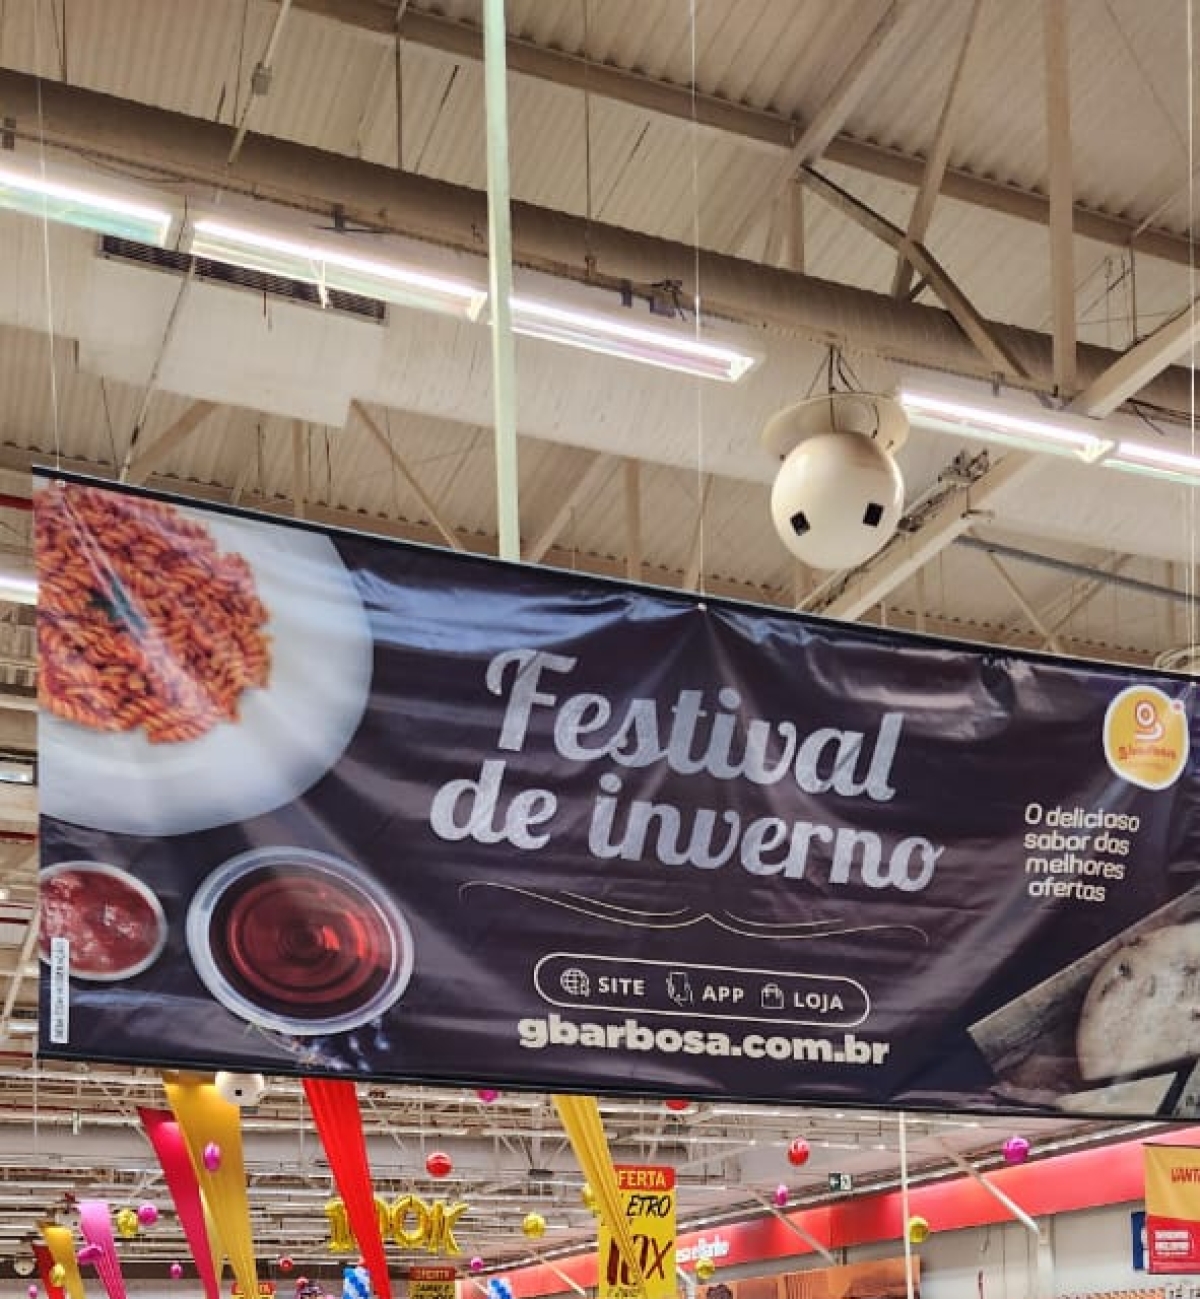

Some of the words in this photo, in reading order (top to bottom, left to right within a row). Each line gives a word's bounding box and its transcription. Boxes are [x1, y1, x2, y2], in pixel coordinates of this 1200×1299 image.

[485, 649, 905, 801] Festival
[429, 760, 558, 849] de
[587, 773, 944, 892] inverno
[1025, 803, 1043, 824] O
[1045, 805, 1140, 832] delicioso
[1024, 830, 1092, 851] sabor
[1094, 831, 1130, 856] das
[1025, 853, 1125, 880] melhores
[1028, 876, 1106, 902] ofertas
[598, 976, 645, 996] SITE
[702, 984, 745, 1004] APP
[793, 991, 844, 1013] LOJA
[517, 1014, 890, 1065] gbarbosa.com.br
[618, 1170, 667, 1187] FERTA
[626, 1194, 672, 1218] ETRO
